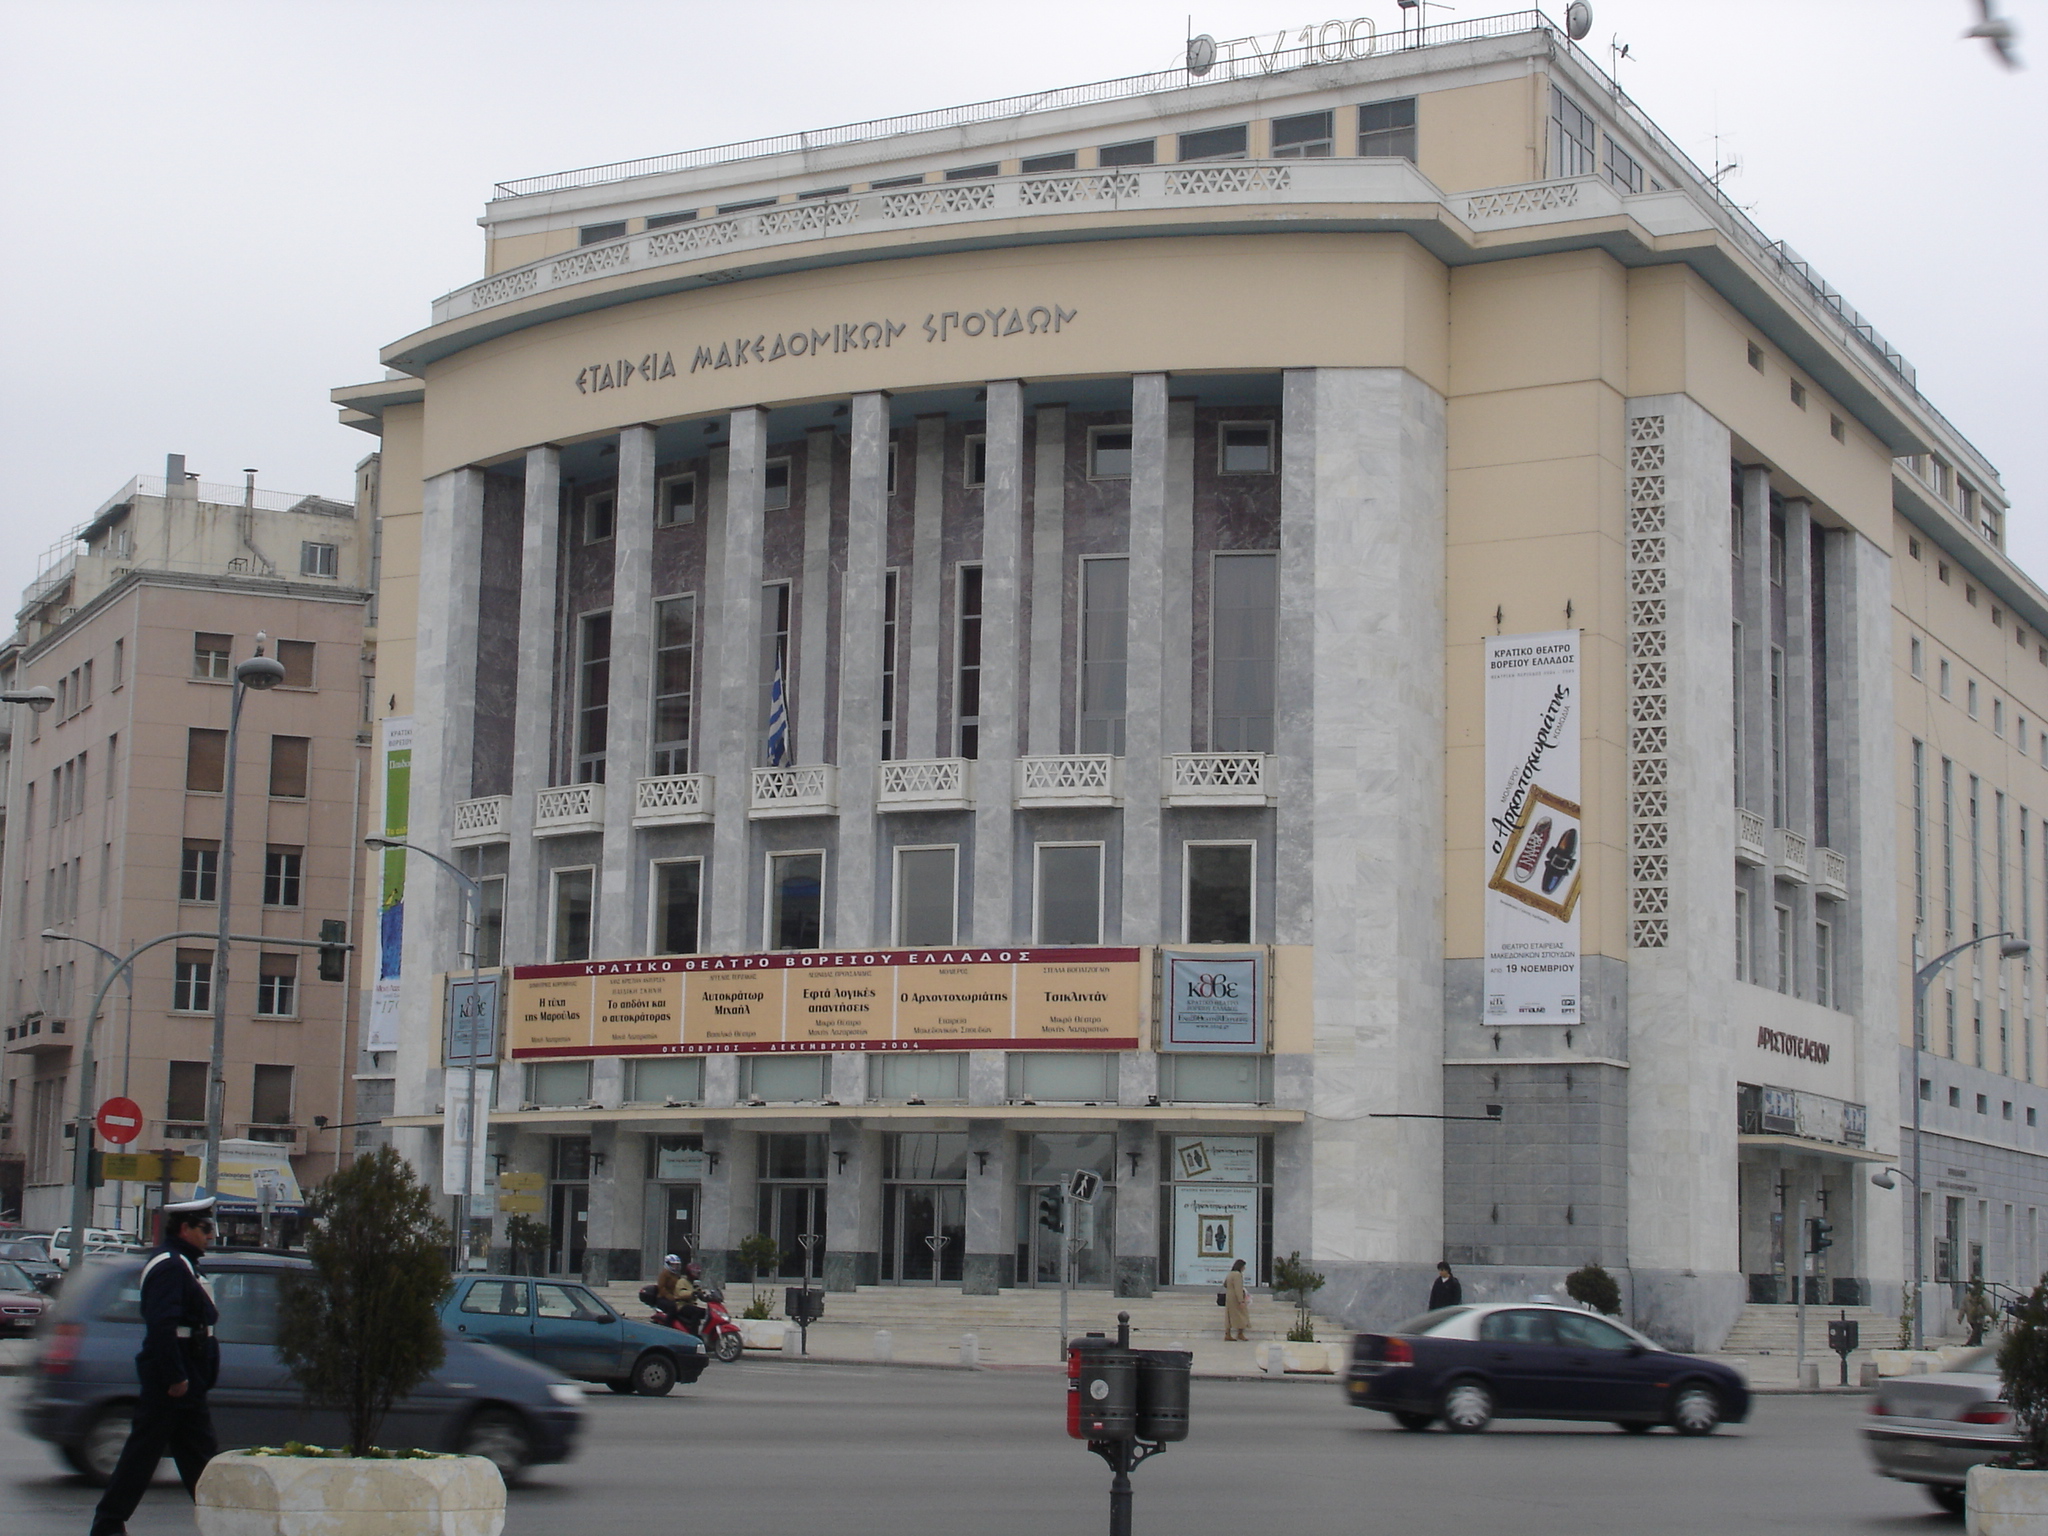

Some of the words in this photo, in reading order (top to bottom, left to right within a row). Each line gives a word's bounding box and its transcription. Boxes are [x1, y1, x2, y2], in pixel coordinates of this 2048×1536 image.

[1215, 30, 1286, 80] TV
[1298, 17, 1376, 67] 100
[575, 351, 677, 395] ΕΤΑΙΡΕΙΑ
[690, 318, 906, 375] ΜΑΚΕΔΟΝΙΚΩΝ
[922, 303, 1078, 343] ΣΠΟΥΔΩΝ
[1494, 647, 1533, 658] ΚΡΑΤΙΚΟ
[1536, 644, 1571, 655] ΘΕΑΤΡΟ
[1490, 658, 1530, 670] ΒΟΡΕΙΟΥ
[1532, 655, 1575, 666] ΕΛΛΑΔΟΣ
[1553, 704, 1571, 740] ΚΩΜΩΔΙΑ
[390, 729, 413, 737] ΚΡΑΤΙΚ
[1501, 765, 1520, 804] ΜΟΛΙΕΡΟΥ
[1501, 942, 1529, 951] ΘΕΑΤΡΟ
[585, 961, 672, 975] ΚΡΑΤΙΚΟ
[685, 957, 770, 970] ΘΕΑΤΡΟ
[785, 954, 892, 967] ΒΟΡΕΙΟΥ
[909, 951, 1030, 964] ΕΛΛΑΔΟΣ
[1506, 964, 1517, 973] 19
[1520, 964, 1575, 973] ΝΟΕΜΒΡΙΟΥ
[702, 990, 764, 1002] Αυτοκράτωρ
[803, 988, 831, 1000] Εφτά
[834, 987, 876, 1000] λογικές
[900, 992, 909, 1003] Ο
[911, 991, 1008, 1004] Αρχοντοχωριάτης
[1044, 991, 1109, 1002] Τσικλιντάν
[539, 998, 546, 1008] Η
[608, 1000, 618, 1009] Το
[620, 999, 650, 1009] αηδόνι
[651, 999, 666, 1008] και
[808, 1002, 870, 1013] απαντήσεις
[714, 1004, 751, 1015] Μιχαήλ
[524, 1013, 538, 1022] της
[540, 1010, 580, 1022] Μαρούλας
[602, 1014, 608, 1022] ο
[609, 1011, 671, 1024] αυτοκράτορας
[662, 1044, 739, 1053] ΟΚΤΩΒΡΙΟΣ
[770, 1043, 866, 1051] ΔΕΚΕΜΒΡΙΟΣ
[881, 1041, 919, 1050] 2004
[1757, 1025, 1830, 1065] ΑΡΙΣΤΟΤΕΛΕΙΟΝ
